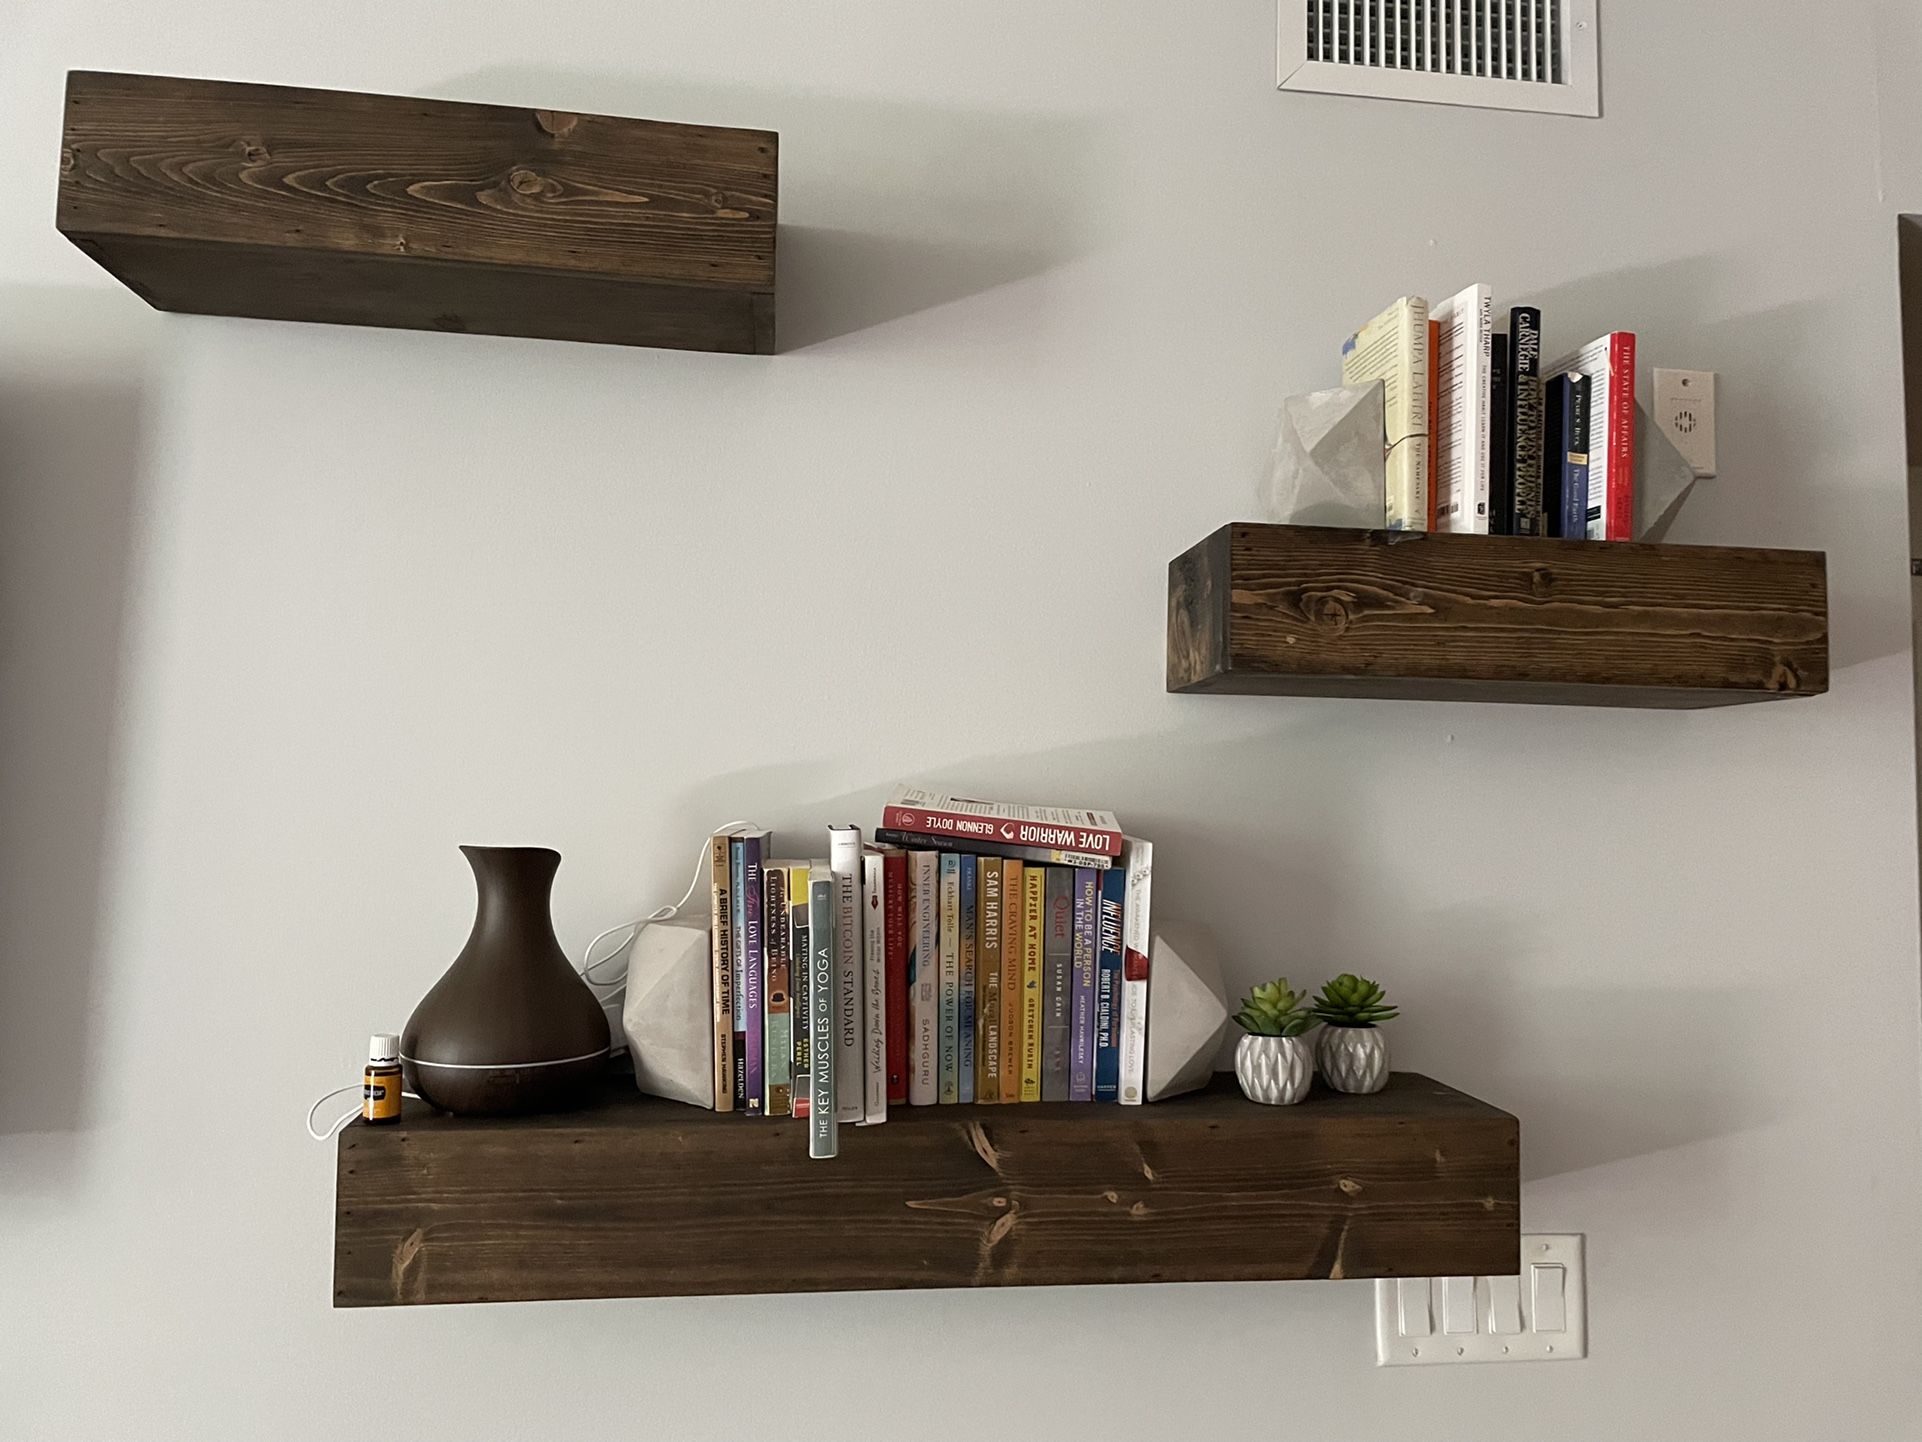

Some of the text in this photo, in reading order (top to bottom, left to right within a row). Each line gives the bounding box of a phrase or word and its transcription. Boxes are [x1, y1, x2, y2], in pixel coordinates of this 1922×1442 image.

[1483, 296, 1491, 324] TWYLA
[1519, 313, 1530, 371] CARNEGIE
[1529, 329, 1538, 358] DALE
[1622, 345, 1630, 365] THE
[1410, 304, 1426, 427] JHUMPA LAHIRI
[1622, 369, 1630, 399] STATE
[1517, 384, 1529, 459] INFLUENCE
[1622, 402, 1630, 413] OF
[1526, 376, 1539, 518] HOW TO WIN FRIENDS
[1621, 420, 1629, 458] AFFAIRS
[1515, 462, 1529, 514] PEOPLE
[926, 816, 994, 834] DOYLE GLENNON
[1020, 824, 1109, 850] WARRIOR LOVE
[748, 863, 758, 881] THE
[720, 898, 728, 926] BRIEF
[986, 871, 998, 949] SAM HARRIS
[1083, 881, 1094, 906] HOW
[749, 920, 758, 946] LOVE
[922, 901, 930, 967] ENGINEERING
[1008, 876, 1018, 991] THE CRAVING MIND
[1028, 875, 1038, 971] HAPPIER AT HOME
[1054, 896, 1071, 938] Quiet
[1074, 899, 1084, 968] IN THE WORLD
[1083, 908, 1094, 922] TO
[1083, 924, 1093, 936] BE
[1101, 899, 1120, 956] INFLUENCE
[720, 930, 729, 971] HISTORY
[842, 873, 854, 1047] THE BITCOIN STANDARD
[1082, 947, 1092, 987] PERSON
[721, 974, 730, 987] OF
[733, 970, 743, 1020] Imperfection
[749, 949, 758, 1009] LANGUAGES
[802, 972, 808, 981] IN
[964, 905, 974, 1067] MAN'S SEARCH FOR MEANING
[989, 972, 998, 989] THE
[1101, 969, 1110, 992] ROBERT
[722, 989, 730, 1015] TIME
[873, 1000, 881, 1014] the
[944, 952, 954, 1072] THE POWER OF NOW
[817, 948, 828, 1138] YOGA OF MUSCLES KEY THE
[872, 1017, 882, 1034] Down
[1100, 1033, 1109, 1048] PH.D.
[871, 1037, 883, 1073] Writing
[922, 1019, 930, 1085] SADHGURU
[988, 1025, 998, 1078] LANDSCAPE
